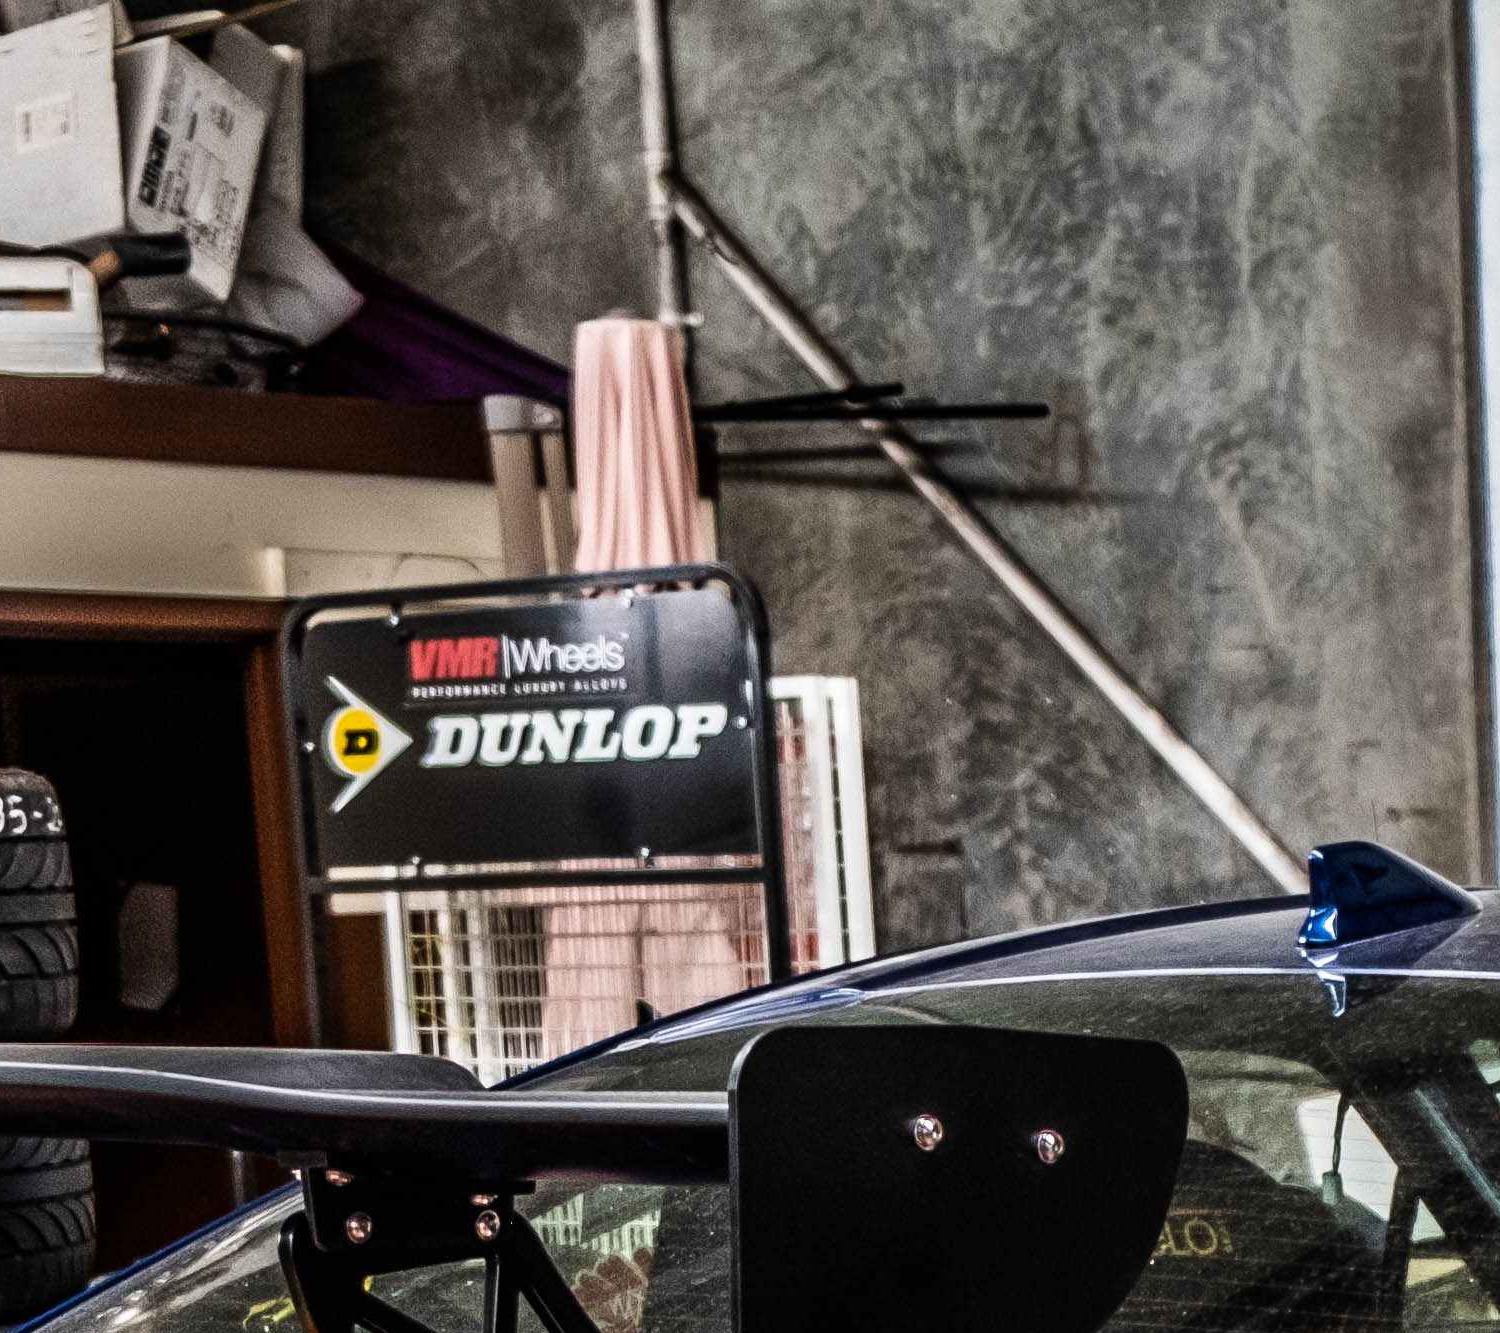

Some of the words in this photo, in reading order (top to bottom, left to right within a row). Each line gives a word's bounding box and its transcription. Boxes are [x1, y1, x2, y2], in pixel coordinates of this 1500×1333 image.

[410, 637, 499, 680] VMR
[509, 635, 625, 673] Wheels
[412, 683, 507, 698] PERFORMANCE
[514, 681, 566, 694] LUXURY
[573, 678, 628, 692] ALLOYS
[421, 704, 728, 767] DUNLOP
